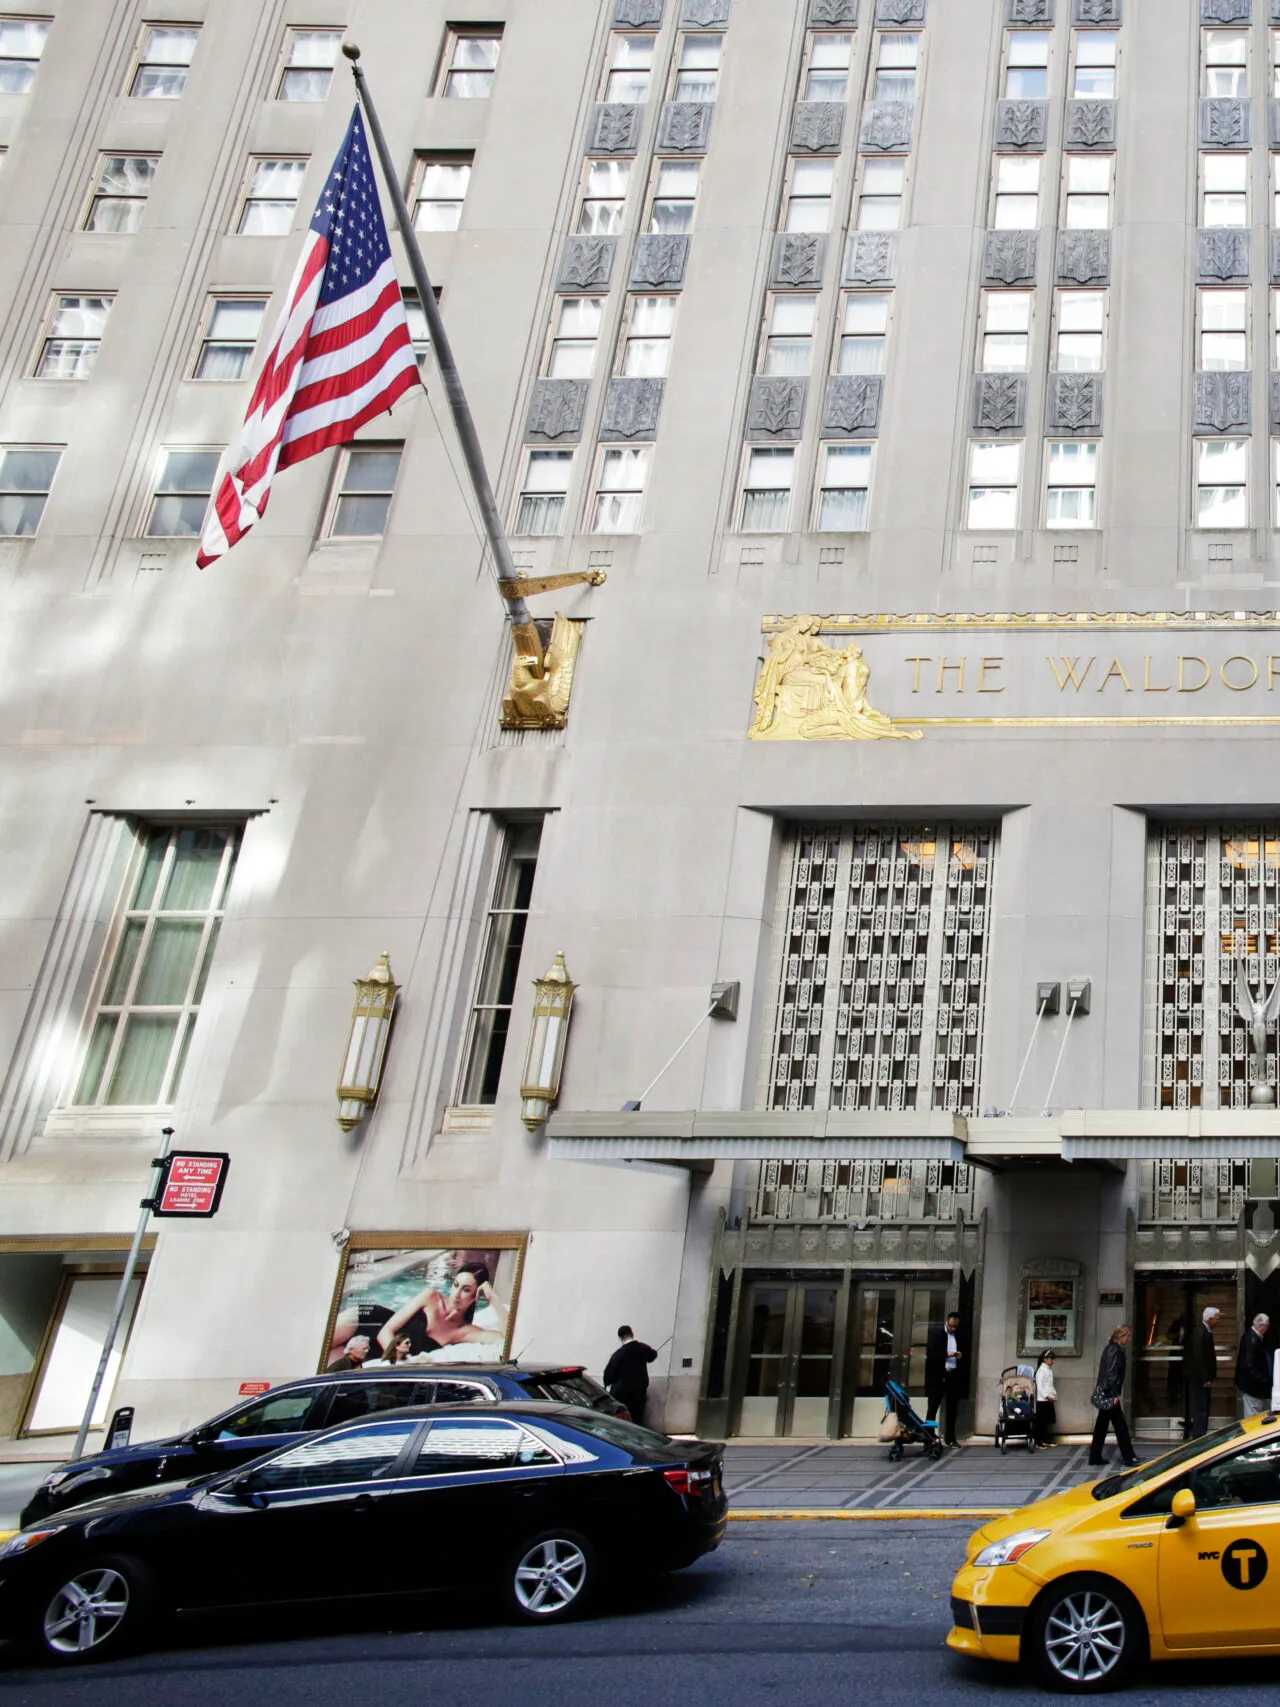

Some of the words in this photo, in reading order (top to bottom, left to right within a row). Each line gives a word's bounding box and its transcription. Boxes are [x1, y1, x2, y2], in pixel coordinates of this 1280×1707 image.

[904, 656, 1006, 694] THE
[187, 1161, 218, 1169] STANDING
[181, 1186, 212, 1194] STANDING
[1198, 1551, 1220, 1560] NYC
[1231, 1549, 1257, 1584] T
